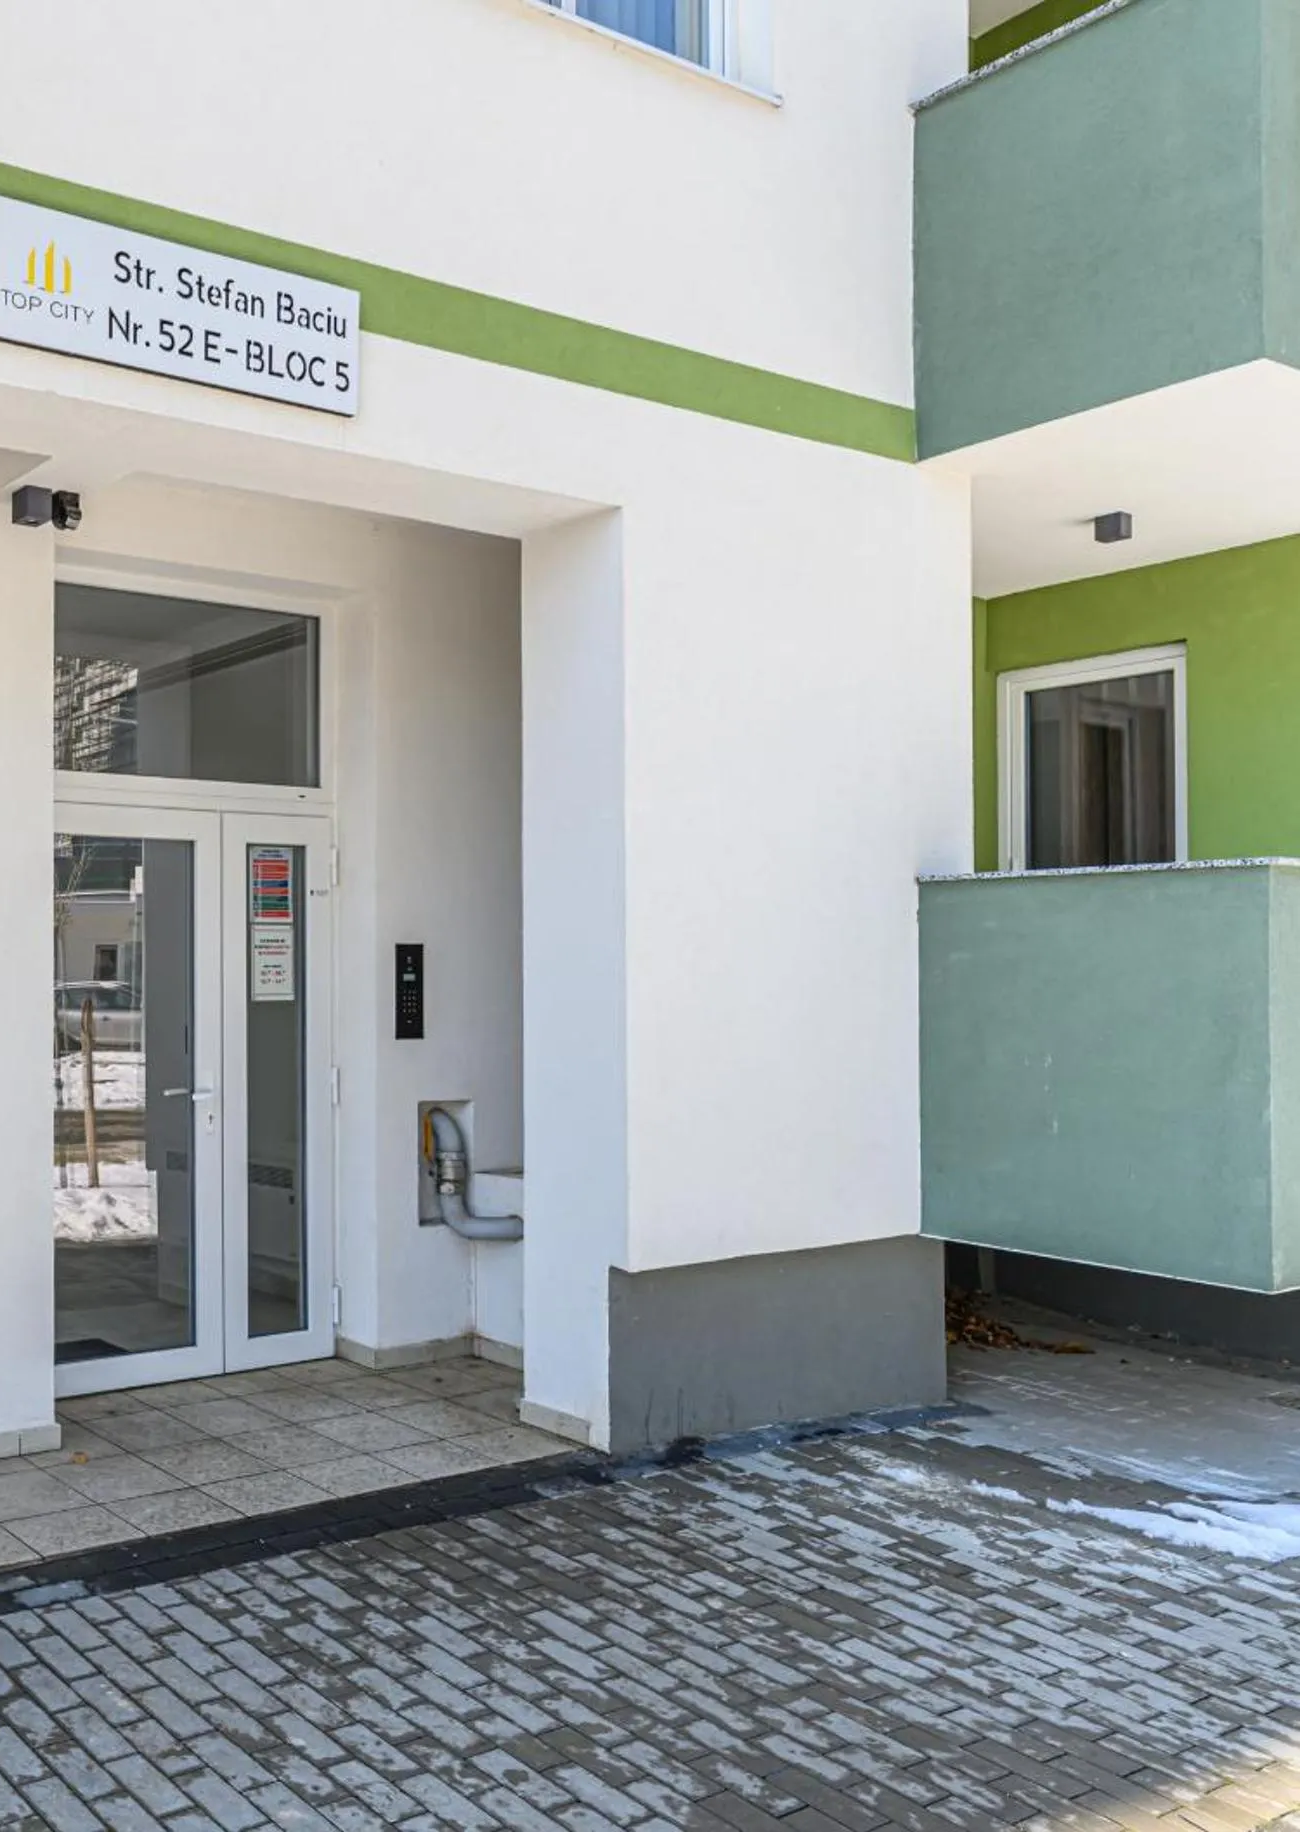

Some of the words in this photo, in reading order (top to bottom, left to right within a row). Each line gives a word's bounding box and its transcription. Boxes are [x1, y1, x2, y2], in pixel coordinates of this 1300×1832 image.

[0, 288, 42, 311] TOP
[49, 300, 96, 325] CITY
[113, 250, 165, 293] Str.
[176, 267, 265, 319] Stefan
[275, 291, 348, 339] Baciu
[107, 307, 151, 348] Nr.
[335, 363, 351, 393] 5
